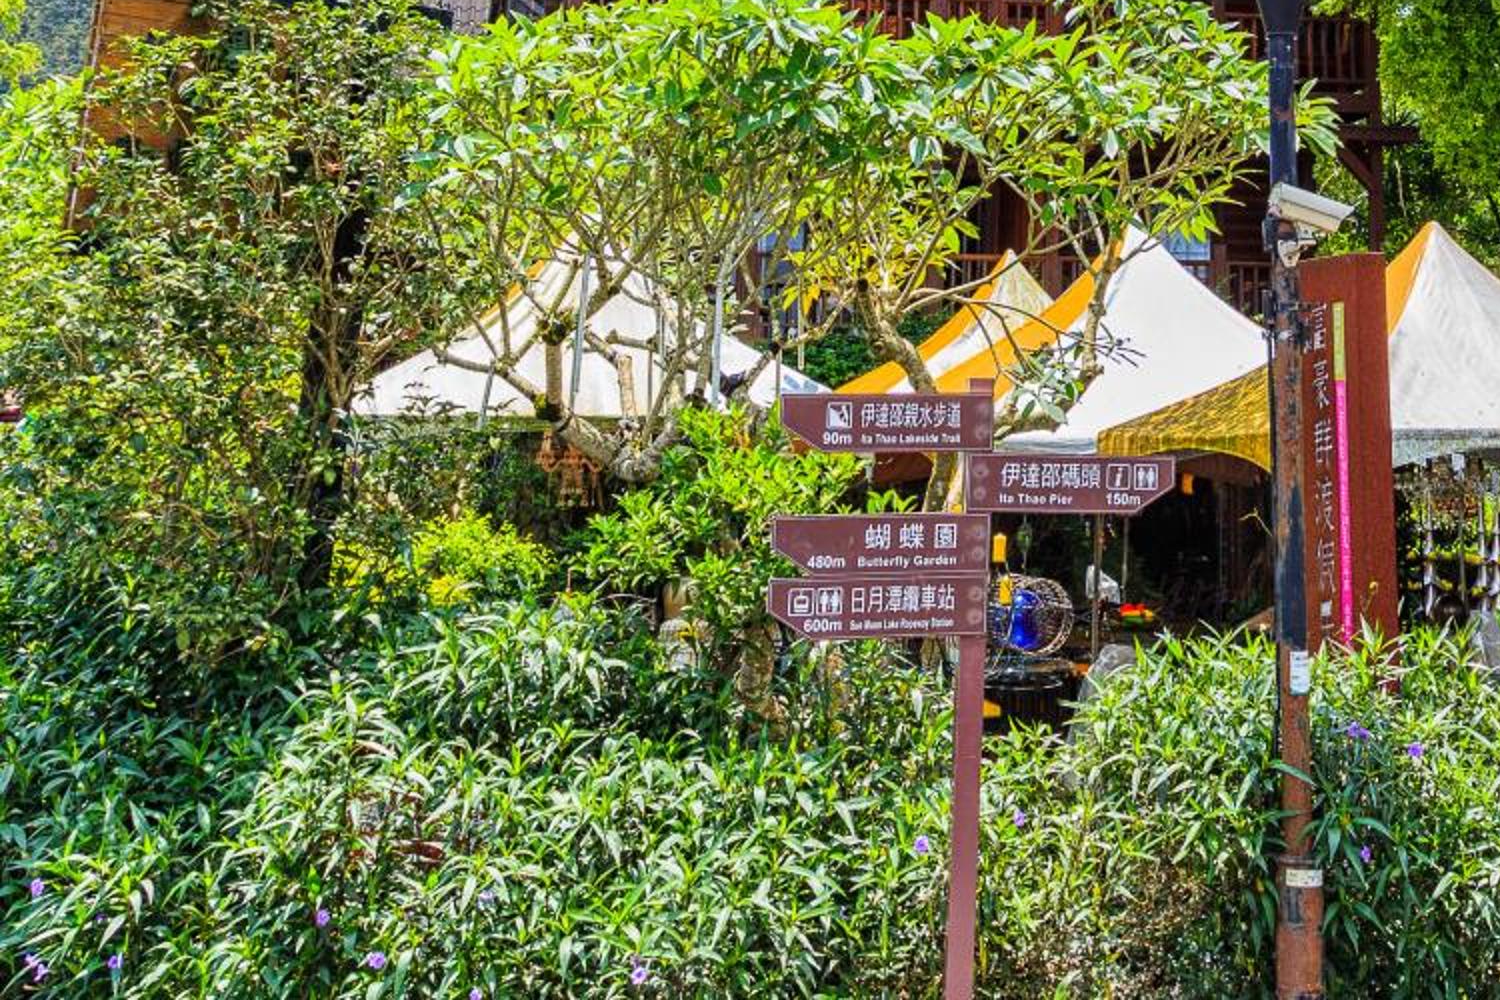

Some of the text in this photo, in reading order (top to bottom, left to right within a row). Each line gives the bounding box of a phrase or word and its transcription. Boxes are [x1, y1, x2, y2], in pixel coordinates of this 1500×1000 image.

[861, 401, 960, 429] 伊達邵親水步道
[823, 431, 853, 446] 90m
[875, 433, 897, 443] Thao
[899, 433, 939, 443] Lakeside
[942, 433, 960, 443] Trail
[1001, 462, 1100, 488] 伊達邵碼頭
[1018, 493, 1046, 504] Thao
[1050, 493, 1073, 504] Pier
[1106, 493, 1141, 505] 150m
[865, 523, 957, 549] 蝴蝶園
[807, 555, 846, 568] 480m
[857, 555, 957, 569] Butterfly Garden
[851, 583, 955, 613] 日月潭纜車站
[803, 618, 842, 632] 600m
